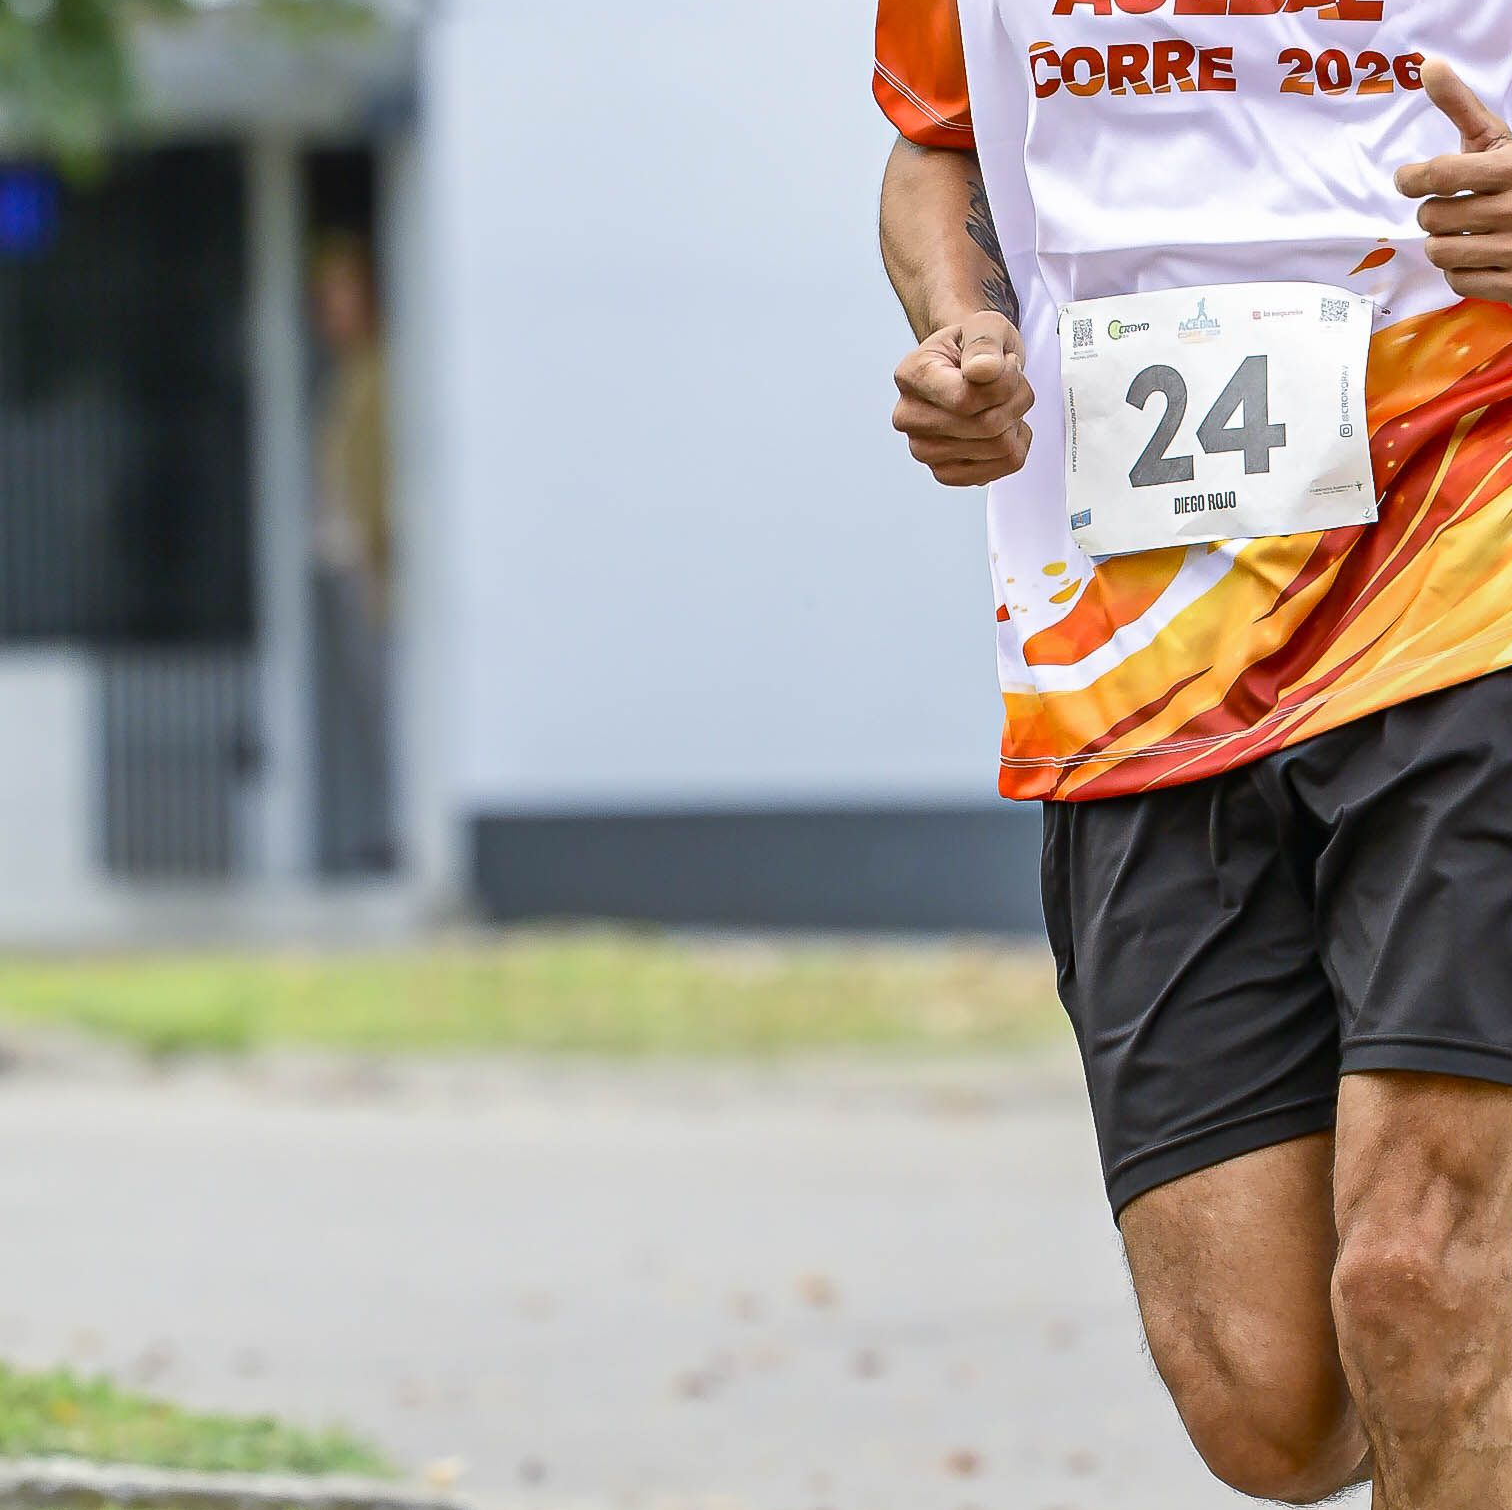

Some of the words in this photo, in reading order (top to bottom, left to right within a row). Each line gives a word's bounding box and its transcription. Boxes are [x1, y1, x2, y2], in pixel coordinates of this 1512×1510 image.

[1029, 39, 1237, 98] CORRE
[1277, 47, 1426, 95] 2026
[1125, 354, 1286, 488] 24
[1174, 494, 1205, 515] DIEGO
[1207, 491, 1237, 511] ROJO
